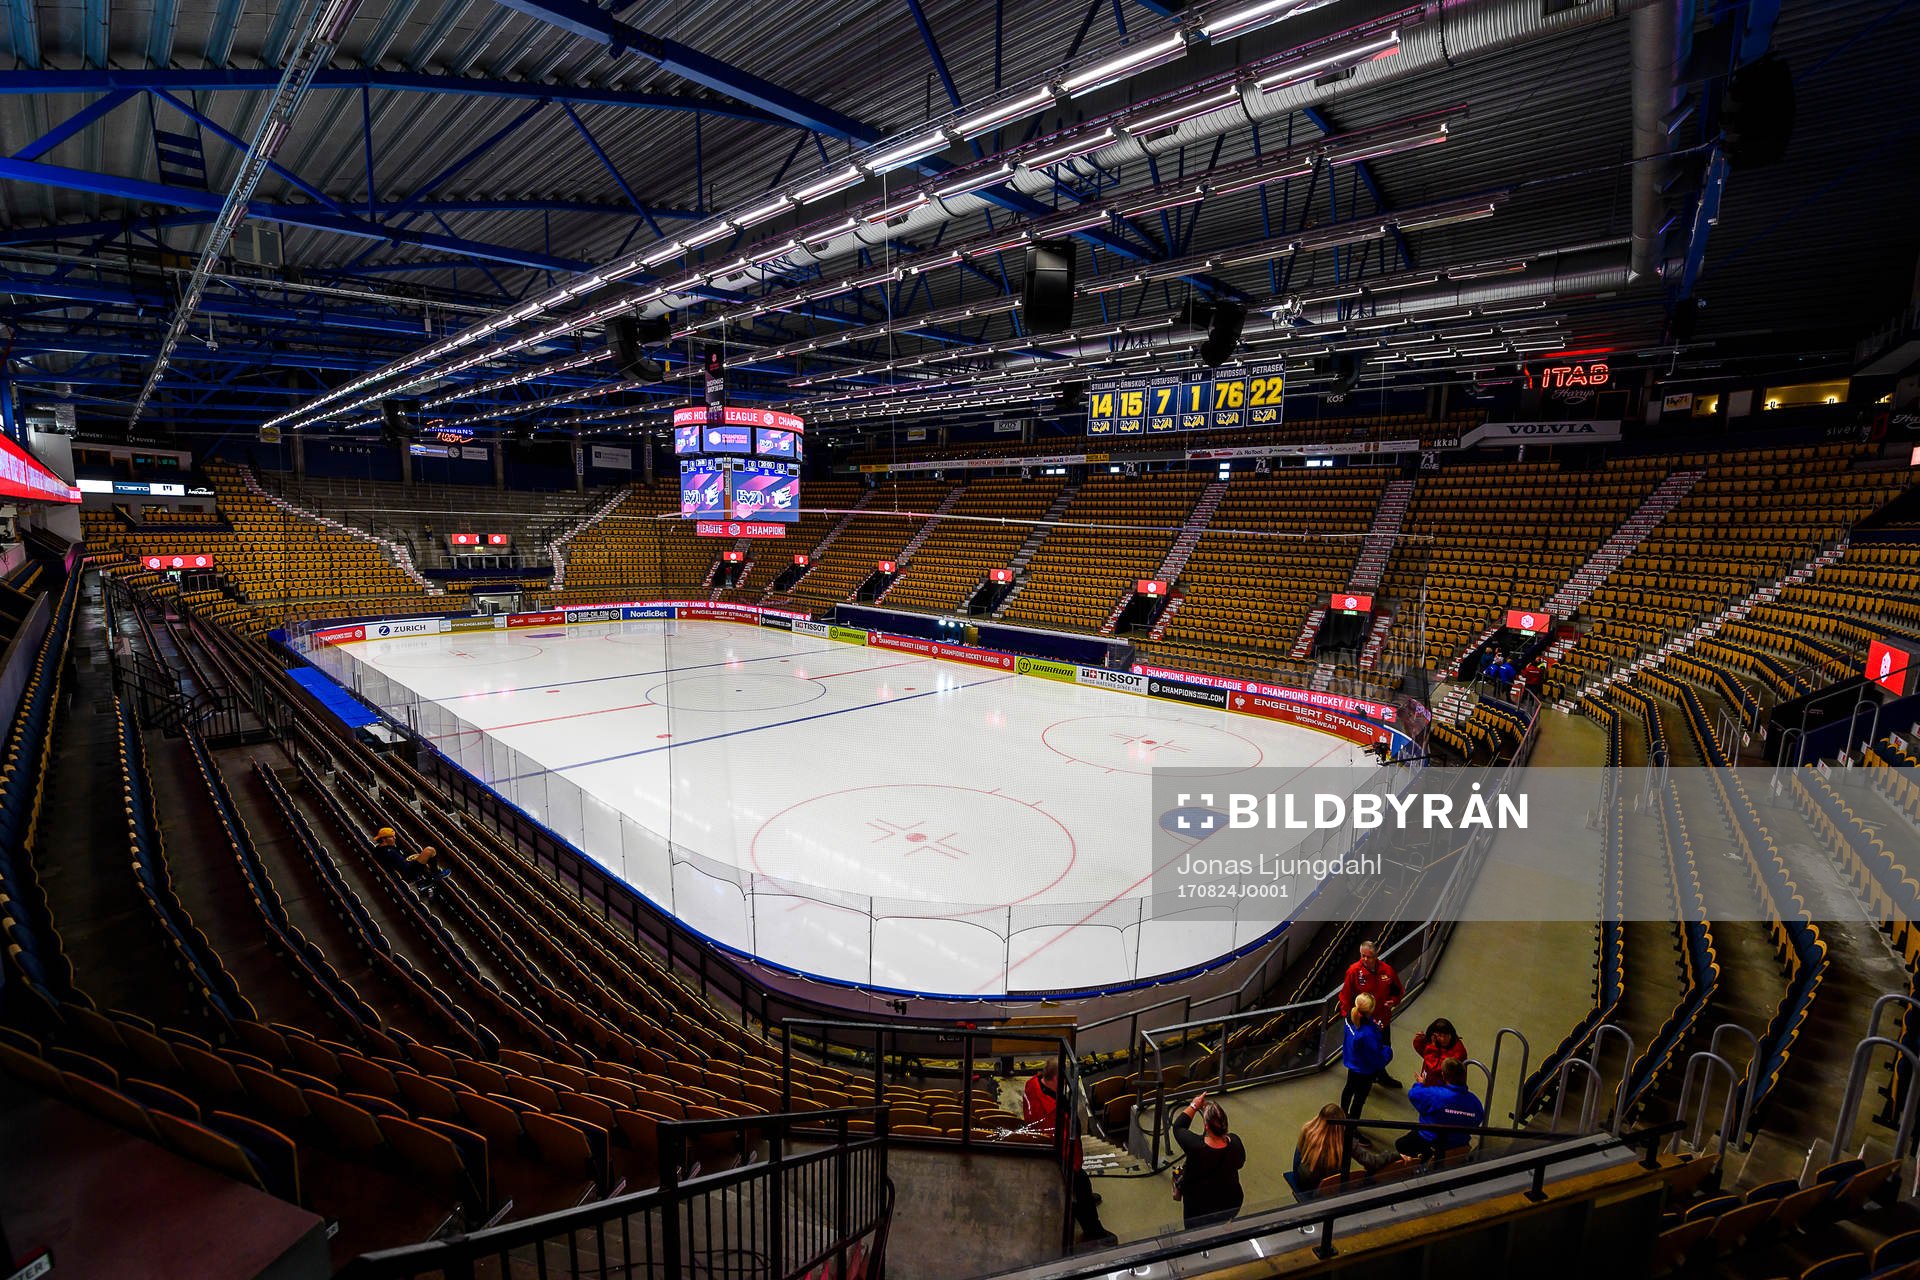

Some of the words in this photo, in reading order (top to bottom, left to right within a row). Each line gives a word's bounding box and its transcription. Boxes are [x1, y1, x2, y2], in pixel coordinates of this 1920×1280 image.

[1216, 368, 1247, 378] DAVIDSSON
[1252, 363, 1284, 374] PETRASEK
[1542, 364, 1608, 388] ITAB
[1151, 376, 1179, 386] GUSTAFSSON
[1191, 373, 1203, 381] LIV
[1091, 381, 1116, 391] STILLMAN
[1250, 377, 1283, 407] 22
[1156, 388, 1172, 415] 7
[1191, 385, 1201, 412] 1
[1215, 381, 1245, 410] 76
[1091, 393, 1113, 418] 14
[1120, 391, 1143, 417] 15
[725, 411, 758, 422] LEAGUE
[1507, 423, 1596, 435] VOLVIA
[699, 524, 723, 534] LEAGUE
[630, 609, 667, 618] NordicBet
[393, 624, 426, 633] ZURICH
[804, 622, 826, 632] TISSOT
[914, 643, 929, 652] LEAGUE
[941, 648, 965, 658] CHAMPIONS
[965, 651, 982, 661] HOCKEY
[982, 653, 1000, 664] LEAGUE
[1032, 663, 1074, 678] WARRIOR
[1098, 671, 1142, 686] TISSOT
[1146, 668, 1184, 682] CHAMPIONS
[1185, 674, 1213, 687] HOCKEY
[1214, 679, 1243, 691] LEAGUE
[1262, 686, 1309, 703] CHAMPIONS
[1310, 694, 1344, 708] HOCKEY
[1345, 700, 1376, 716] LEAGUE
[1254, 698, 1322, 719] ENGELBERT
[1324, 713, 1374, 736] STRAUSS
[1295, 715, 1337, 731] WORKWEAR
